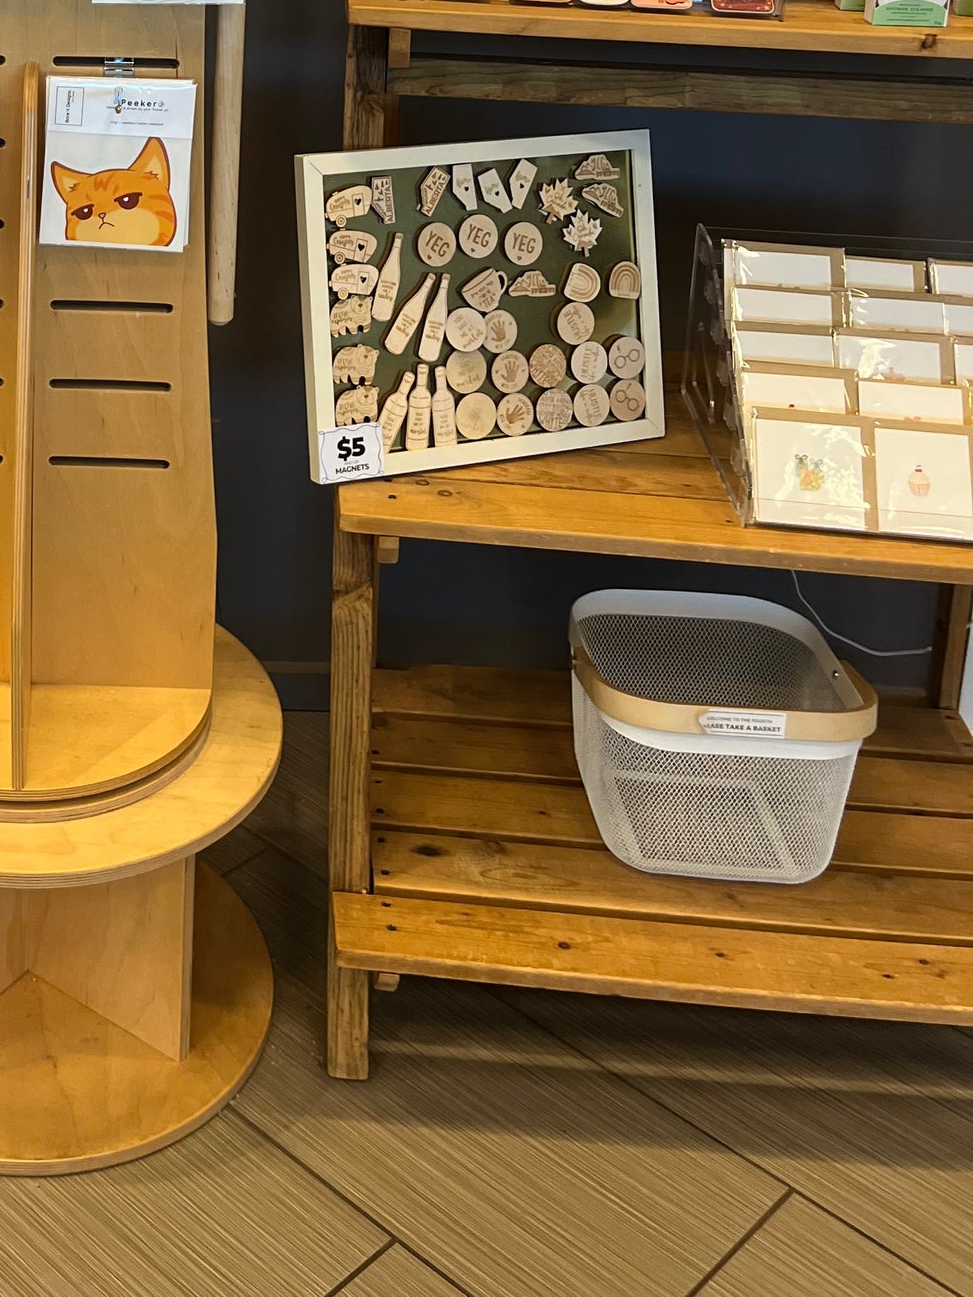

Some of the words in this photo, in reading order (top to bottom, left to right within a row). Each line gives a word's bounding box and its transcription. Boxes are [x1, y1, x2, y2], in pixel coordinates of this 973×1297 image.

[121, 99, 158, 108] Peeker
[384, 185, 394, 222] ALBERTA
[426, 181, 446, 214] ALBERTA
[425, 230, 450, 258] YEG
[466, 223, 491, 248] YEG
[512, 232, 536, 254] YEG
[337, 436, 365, 462] $5
[335, 464, 369, 474] MAGNETS
[753, 725, 781, 733] BASKET
